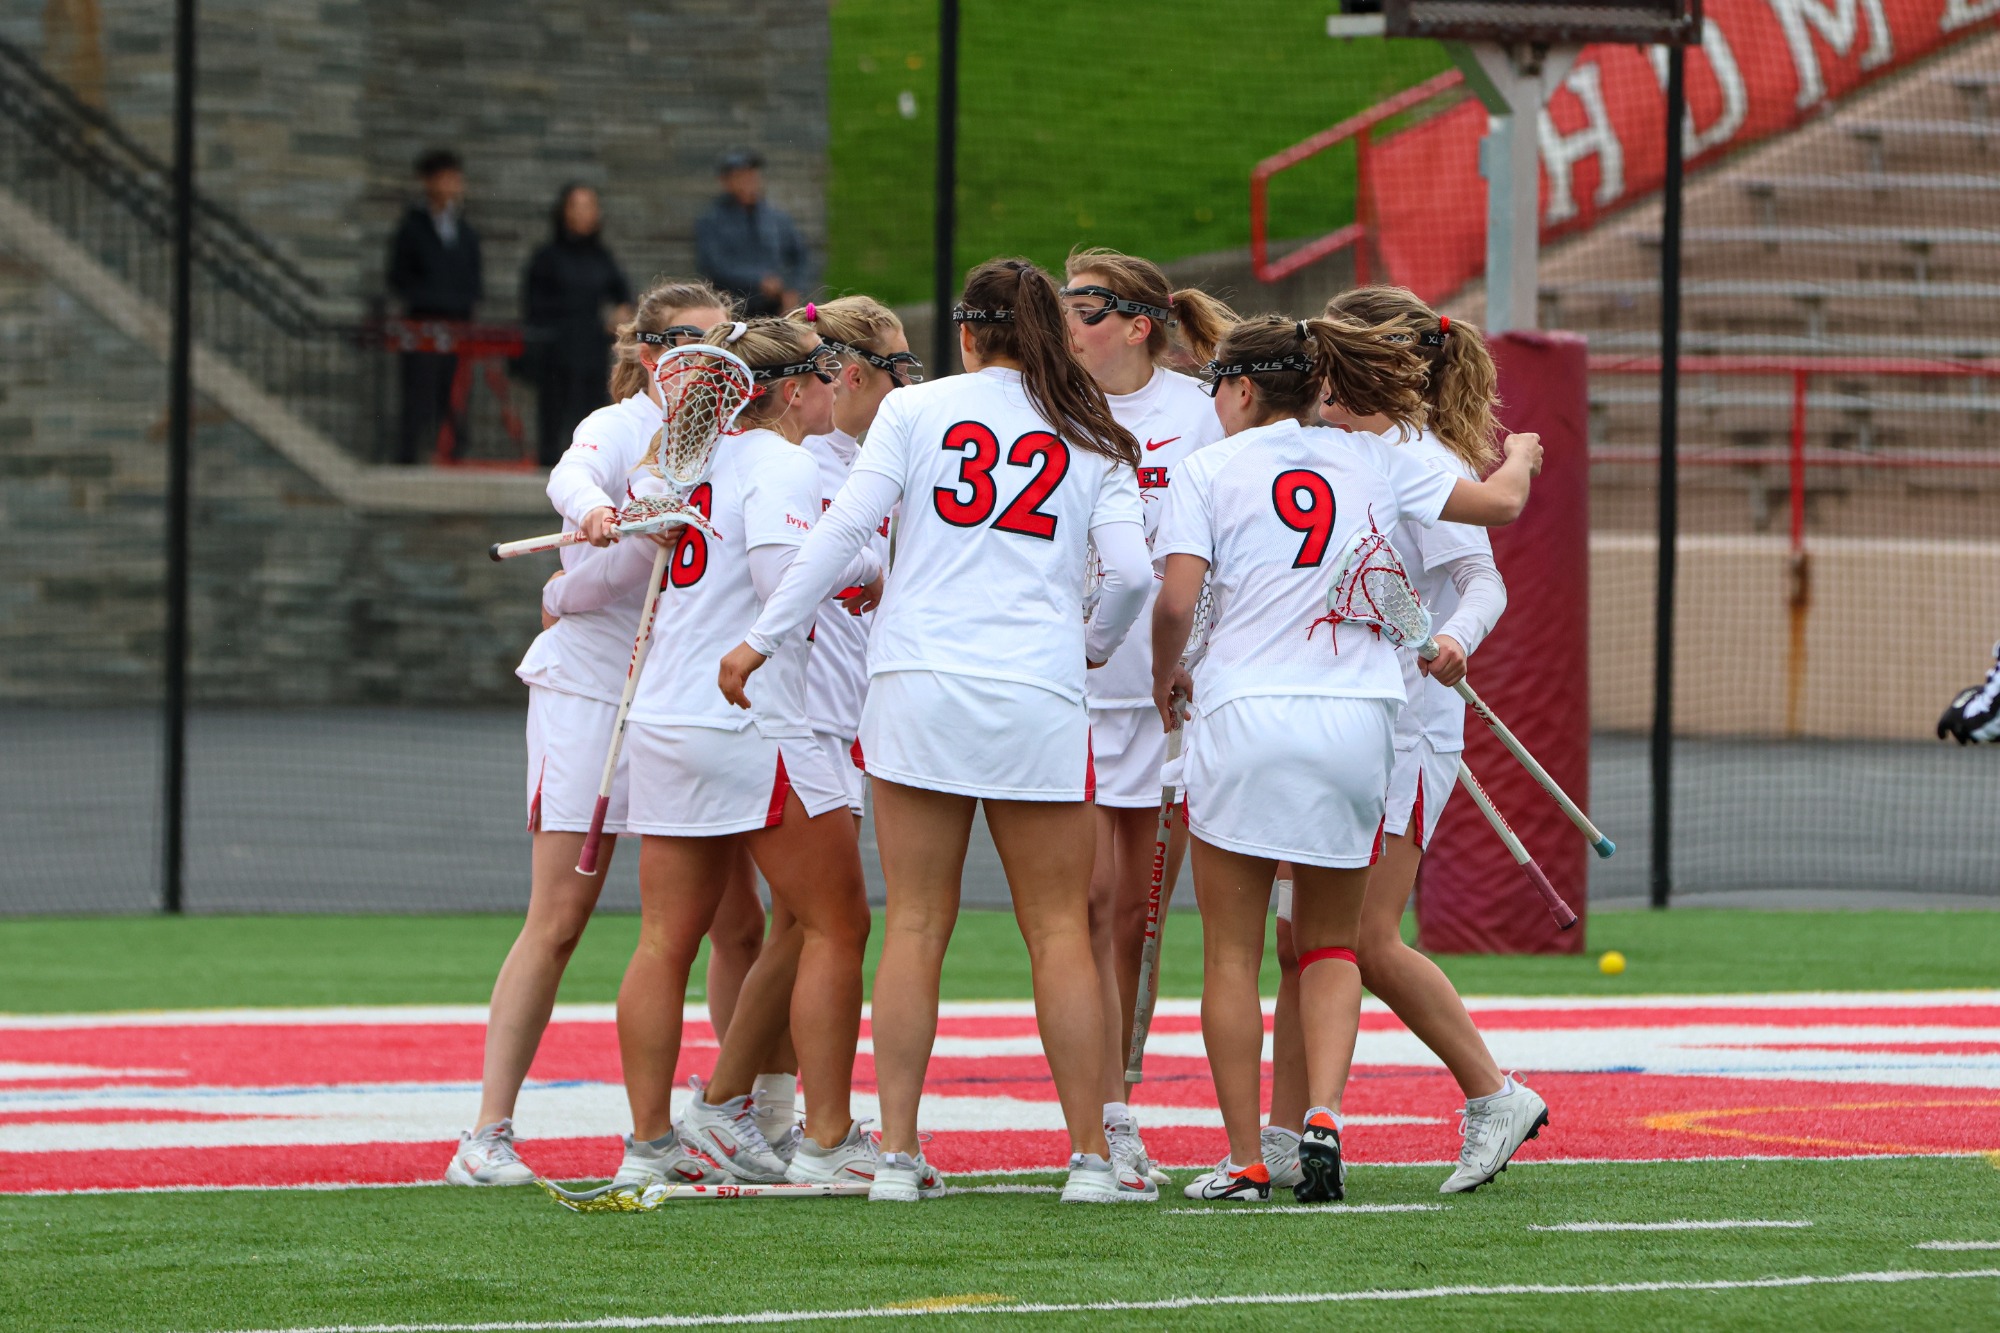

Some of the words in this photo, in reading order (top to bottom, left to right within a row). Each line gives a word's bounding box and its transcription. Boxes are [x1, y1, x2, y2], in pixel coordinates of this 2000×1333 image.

[1537, 0, 2000, 226] HOM
[966, 309, 987, 319] STX
[1127, 302, 1153, 315] STX
[645, 333, 663, 343] STX
[869, 356, 894, 368] ST
[1214, 364, 1243, 376] STX
[1251, 361, 1284, 372] STX
[751, 369, 772, 379] TX
[783, 363, 815, 376] STX
[933, 420, 1071, 541] 32
[785, 513, 802, 529] Ivy
[1272, 468, 1336, 569] 9
[660, 481, 712, 593] 8
[1143, 840, 1167, 943] CORNELL
